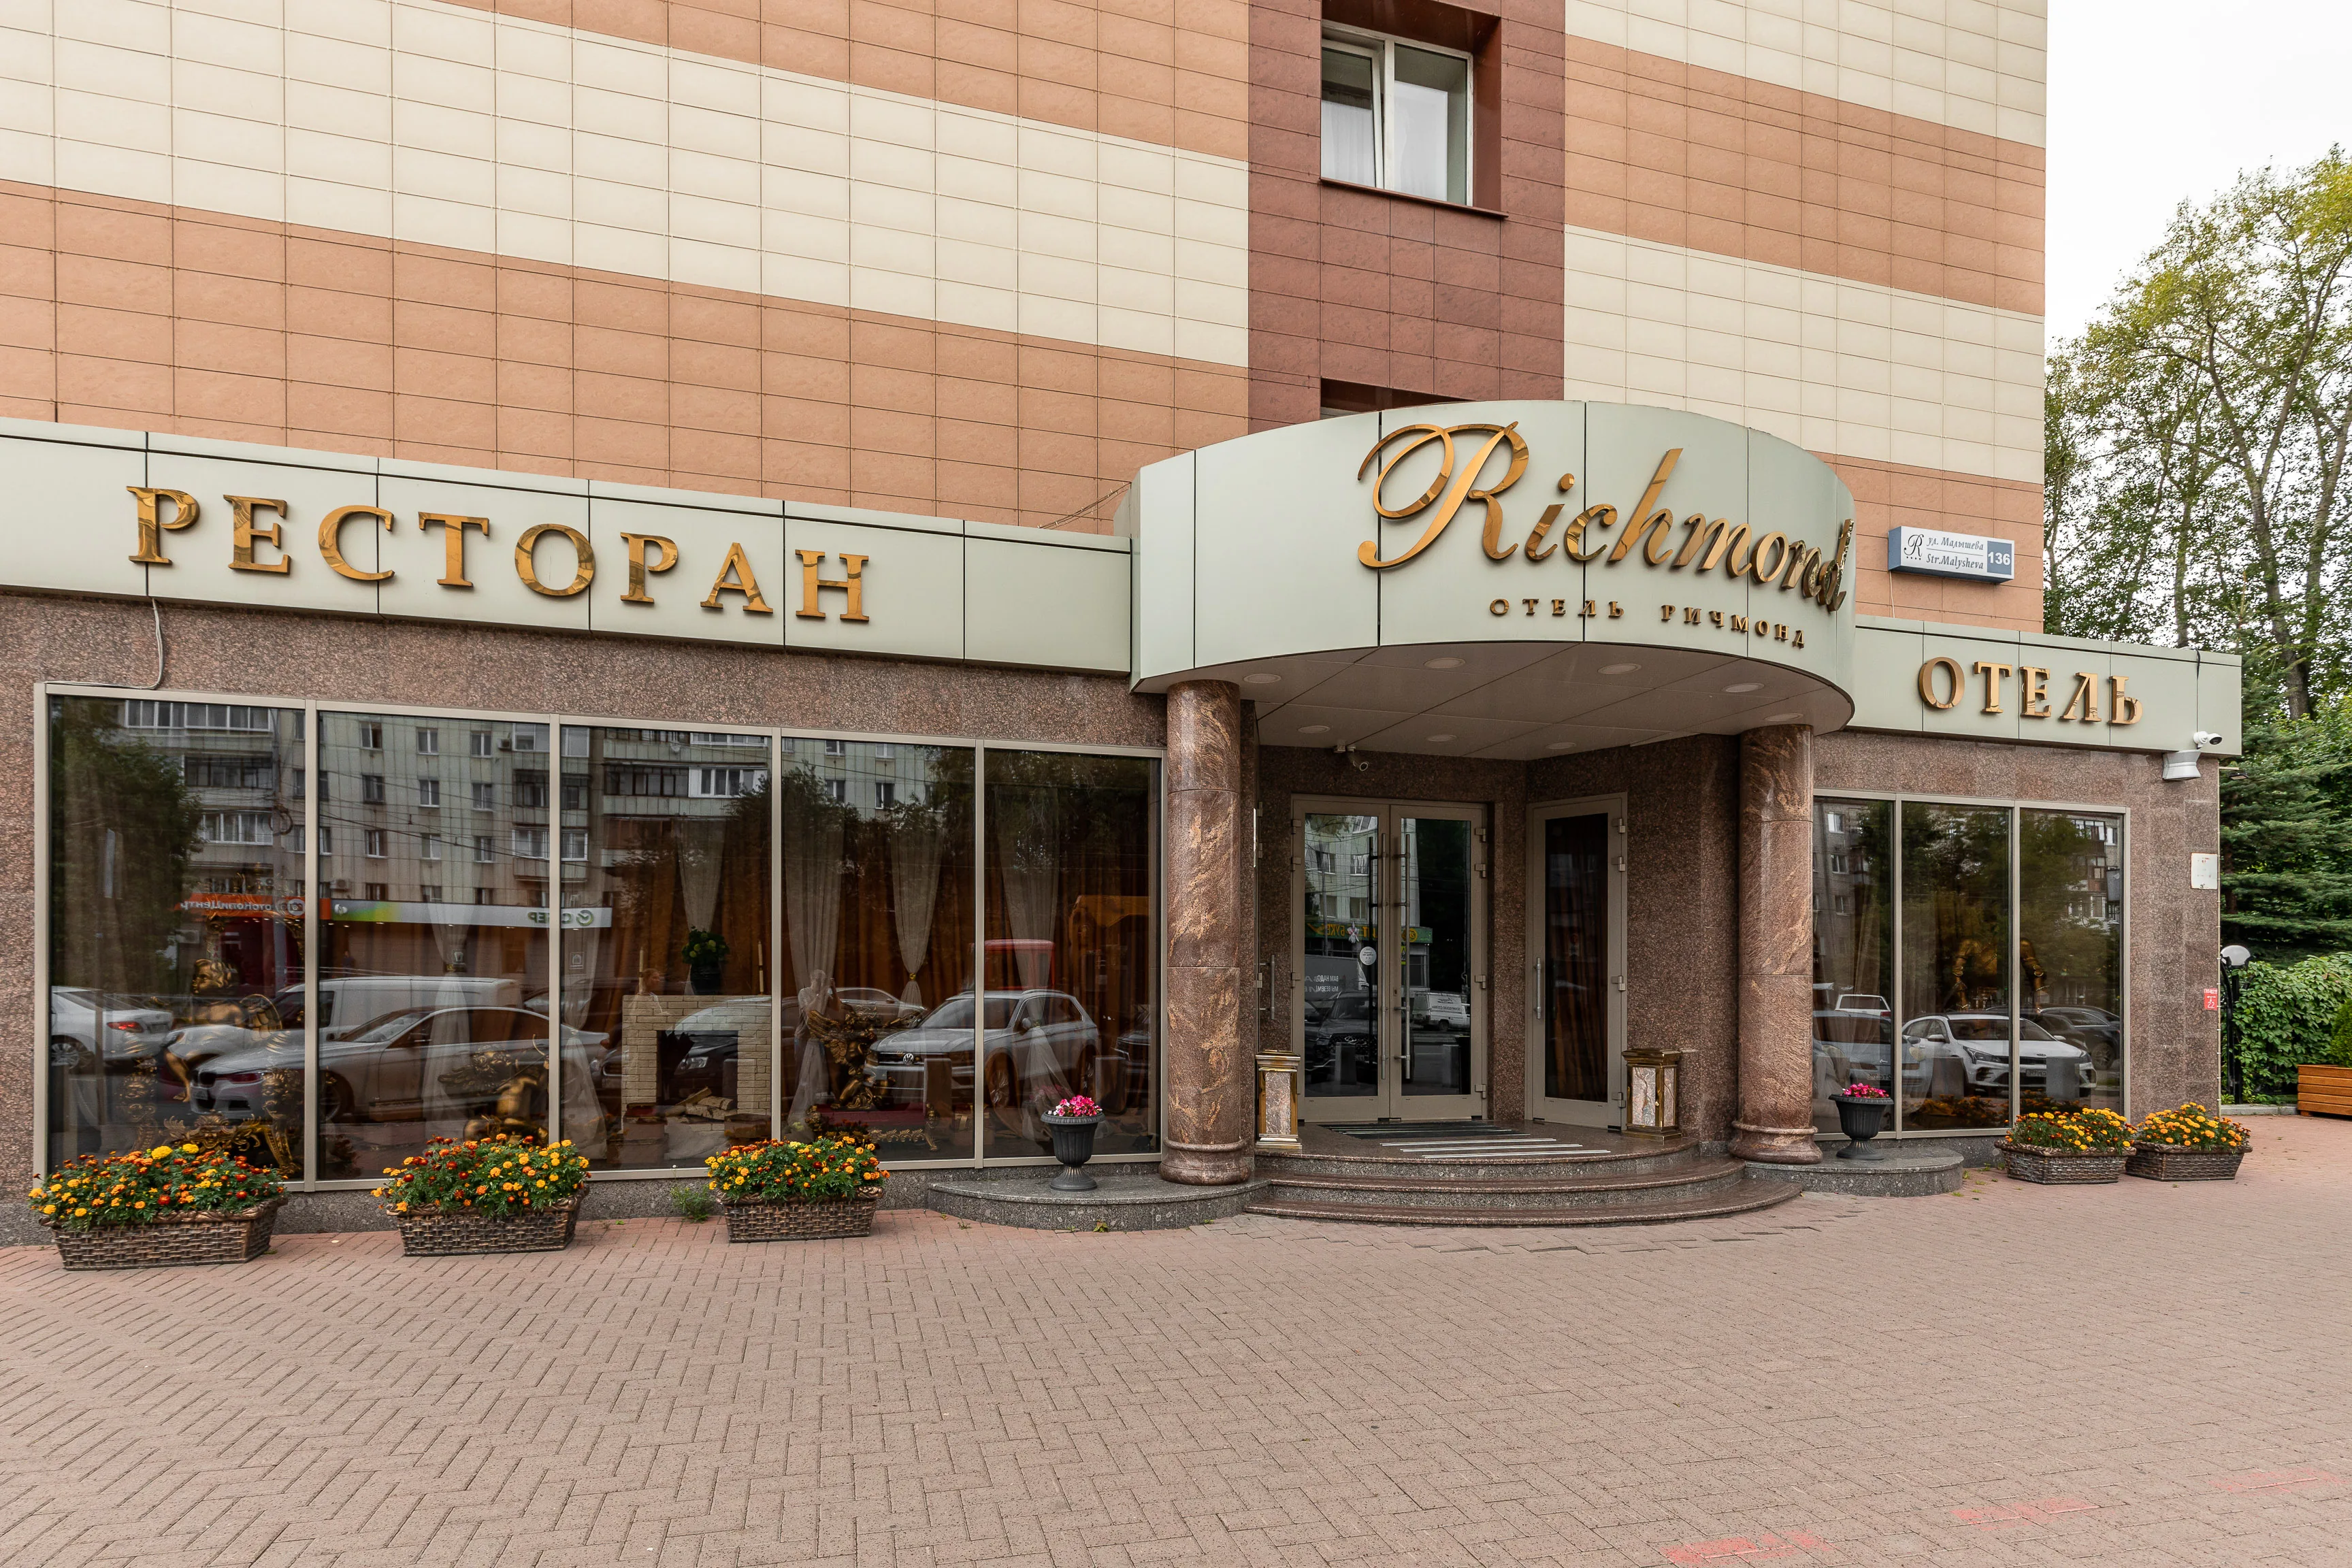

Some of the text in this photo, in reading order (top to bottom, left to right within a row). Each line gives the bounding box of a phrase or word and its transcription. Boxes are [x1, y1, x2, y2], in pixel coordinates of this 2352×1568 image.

[1357, 421, 1856, 612] Richmond
[1926, 536, 1984, 551] ул. Малышева
[126, 485, 870, 622] РЕСТОРАН
[1988, 551, 2011, 566] 136
[1489, 598, 1805, 649] ОТЕЛЬ РИЧМОНД
[1918, 656, 2144, 725] ОТЕЛЬ
